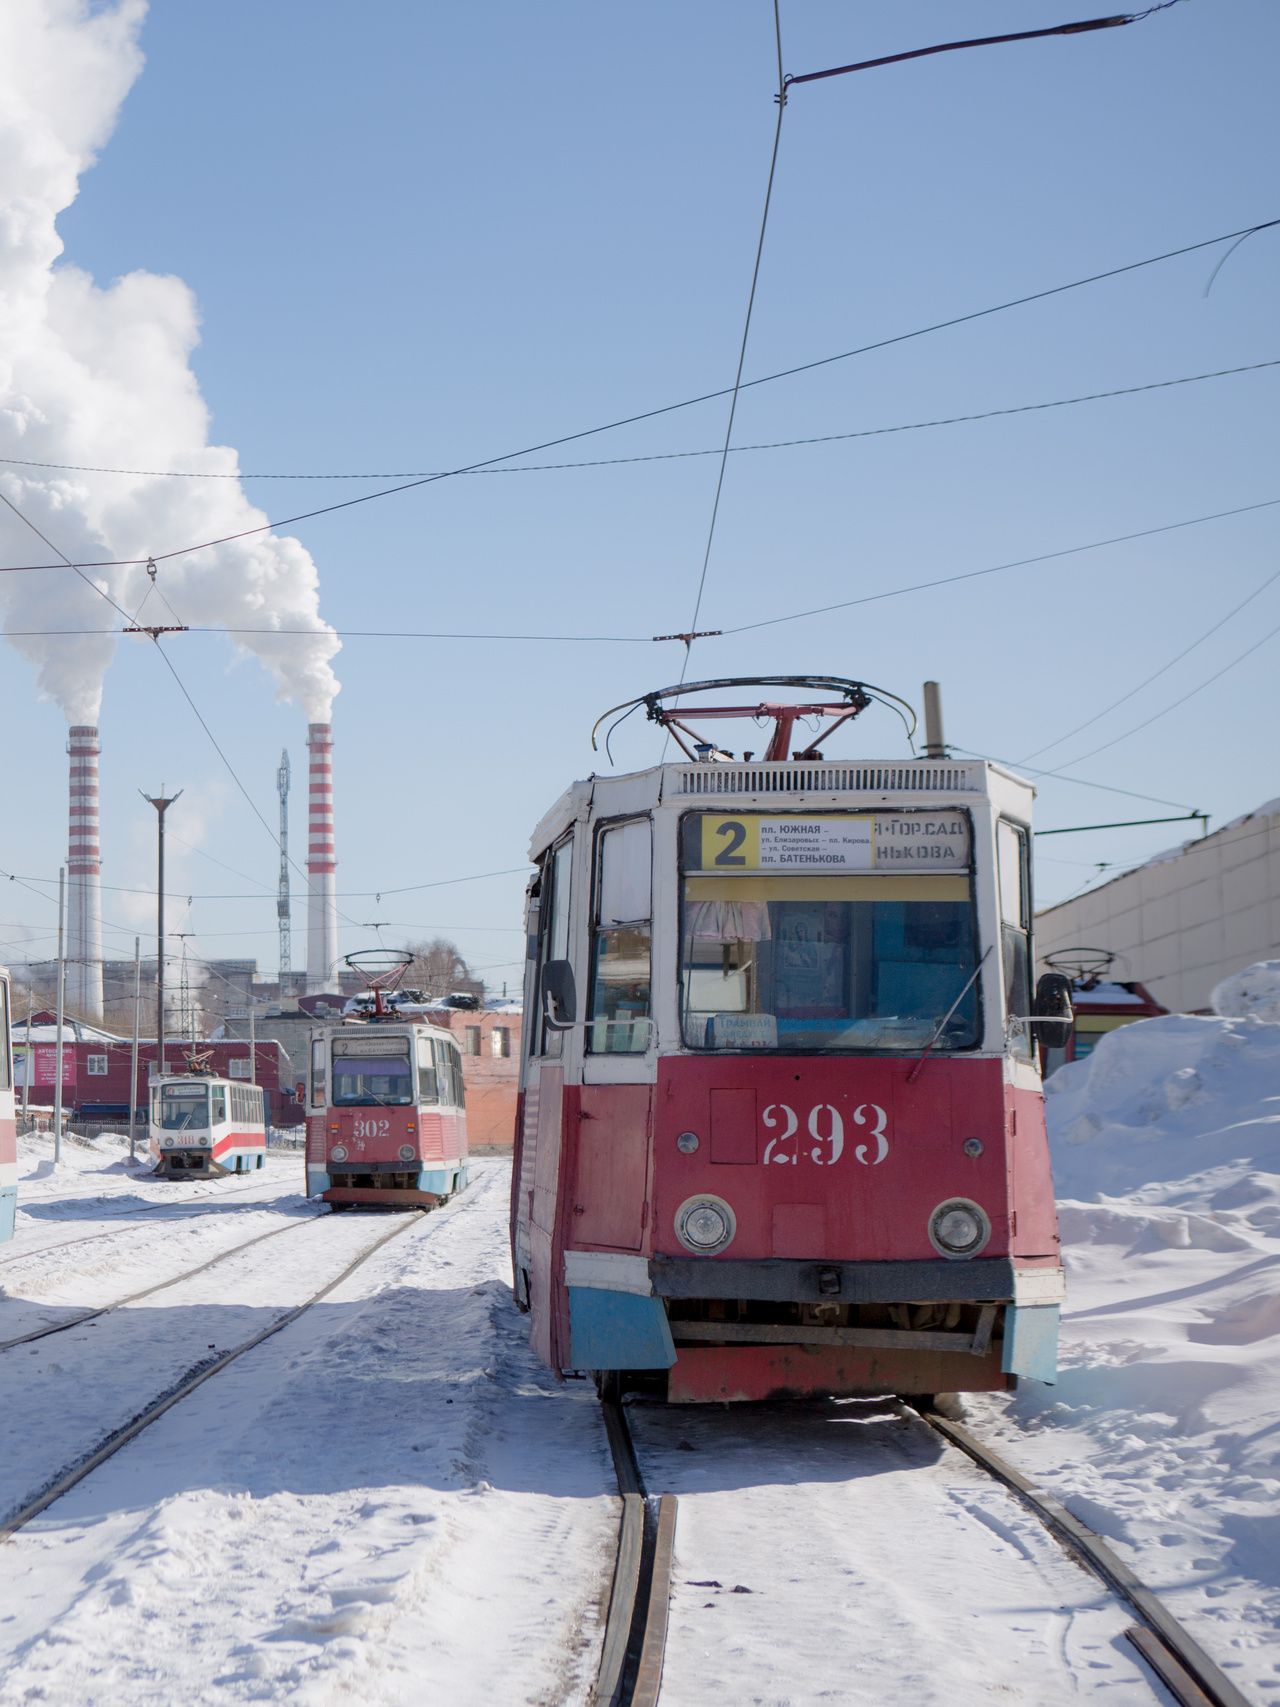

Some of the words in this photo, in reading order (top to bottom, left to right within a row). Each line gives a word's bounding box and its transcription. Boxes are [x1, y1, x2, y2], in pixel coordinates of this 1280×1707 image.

[779, 825, 821, 834] ЮЖНАЯ
[715, 821, 746, 865] 2
[761, 855, 777, 863] пл.
[779, 854, 846, 863] БАТЕНЬКОВА
[719, 1016, 771, 1028] ТРАМВАЙ
[353, 1120, 390, 1137] 302
[762, 1103, 889, 1165] 293
[177, 1135, 195, 1145] 318
